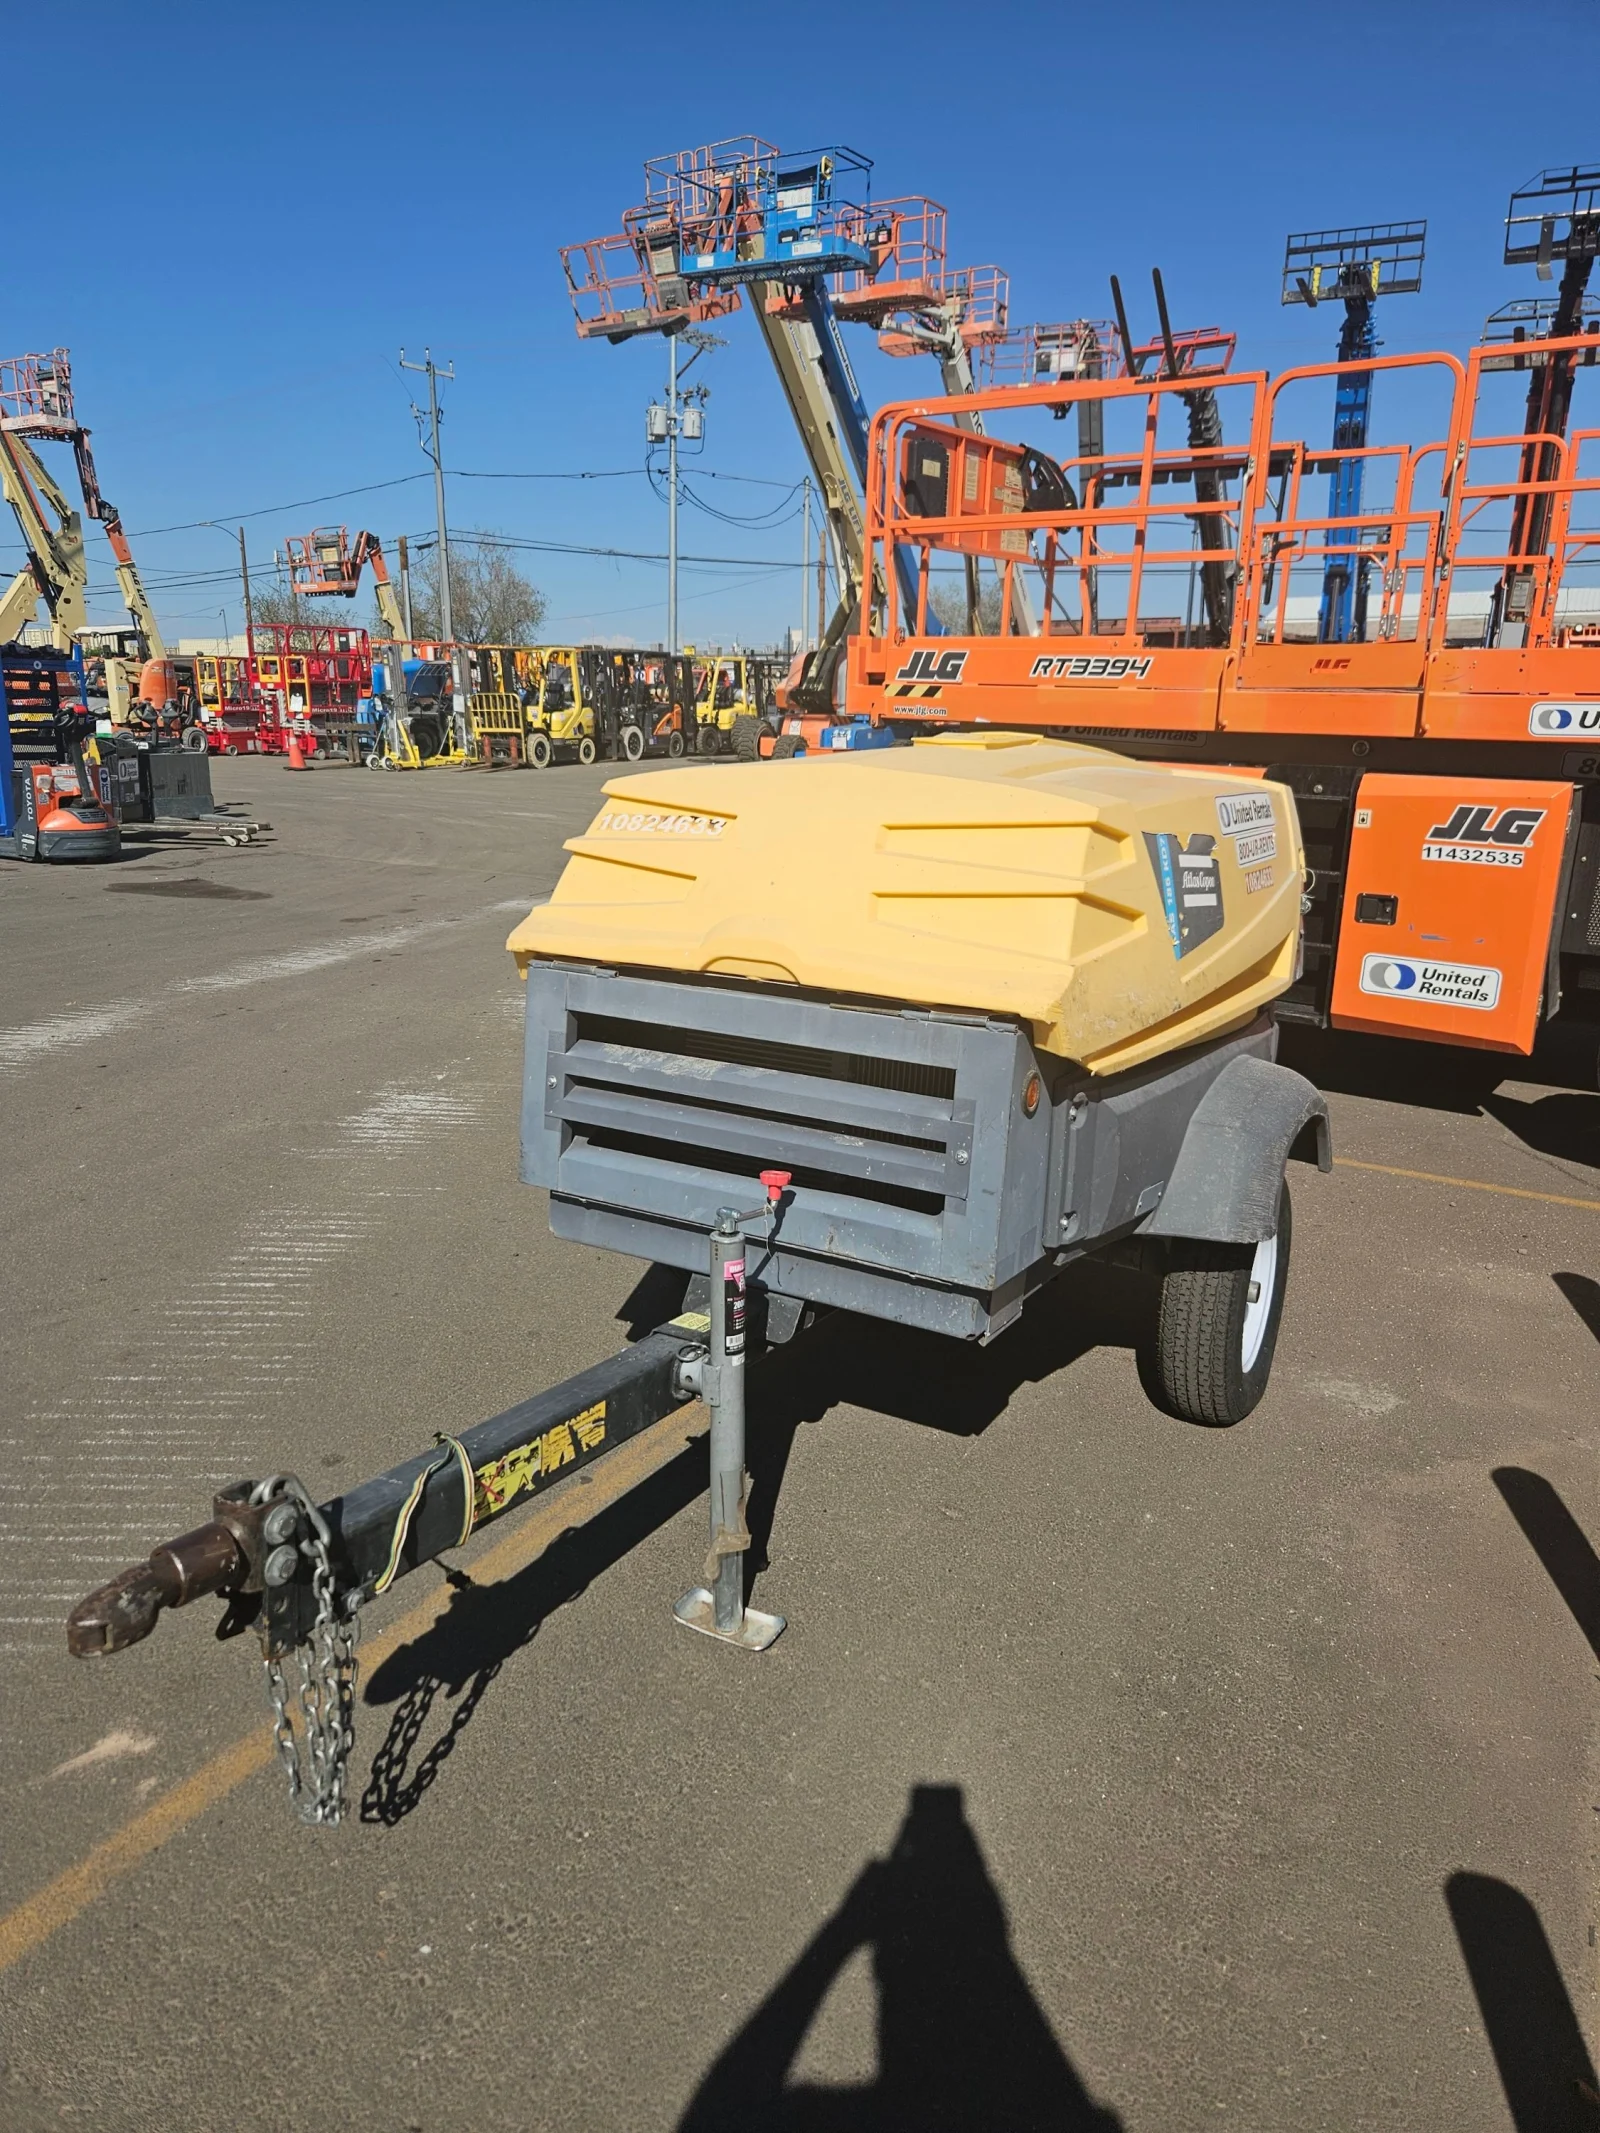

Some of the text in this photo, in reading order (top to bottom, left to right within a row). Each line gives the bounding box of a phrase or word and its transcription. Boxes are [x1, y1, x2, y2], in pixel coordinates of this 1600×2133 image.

[129, 569, 149, 609] JLG LIFT
[896, 650, 968, 681] JLG
[1030, 656, 1152, 678] RT3394
[894, 705, 947, 716] www.jlg.com
[25, 777, 34, 821] TOYOTA
[1229, 798, 1272, 825] United Rentals
[598, 813, 727, 836] 10824633
[1426, 805, 1547, 846] JLG
[1422, 846, 1523, 866] 11432535
[1182, 871, 1200, 889] Atlas
[1422, 967, 1486, 987] United
[1419, 981, 1489, 1002] Rentals
